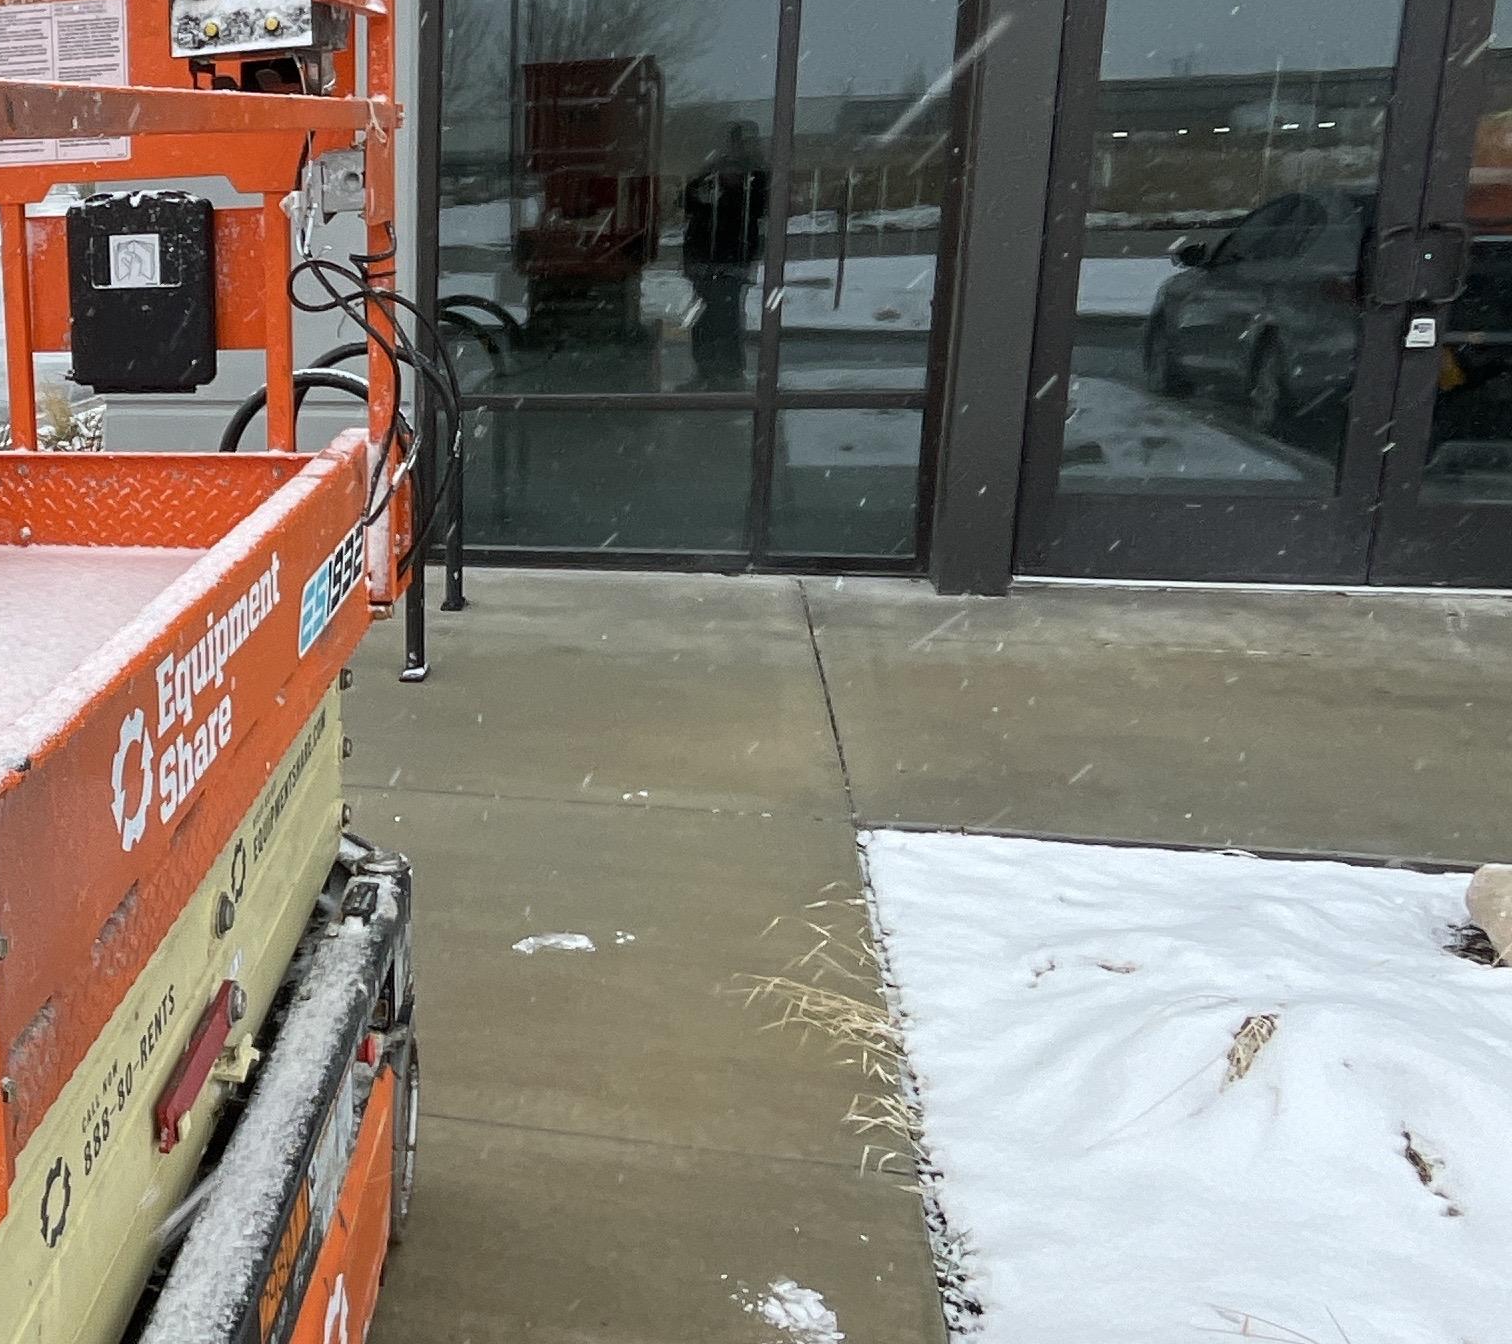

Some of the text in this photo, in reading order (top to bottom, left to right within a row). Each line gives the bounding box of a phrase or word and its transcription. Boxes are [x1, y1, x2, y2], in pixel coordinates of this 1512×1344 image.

[155, 551, 280, 738] Equipment
[159, 694, 232, 824] Share
[83, 983, 175, 1177] 888-80-RENTS
